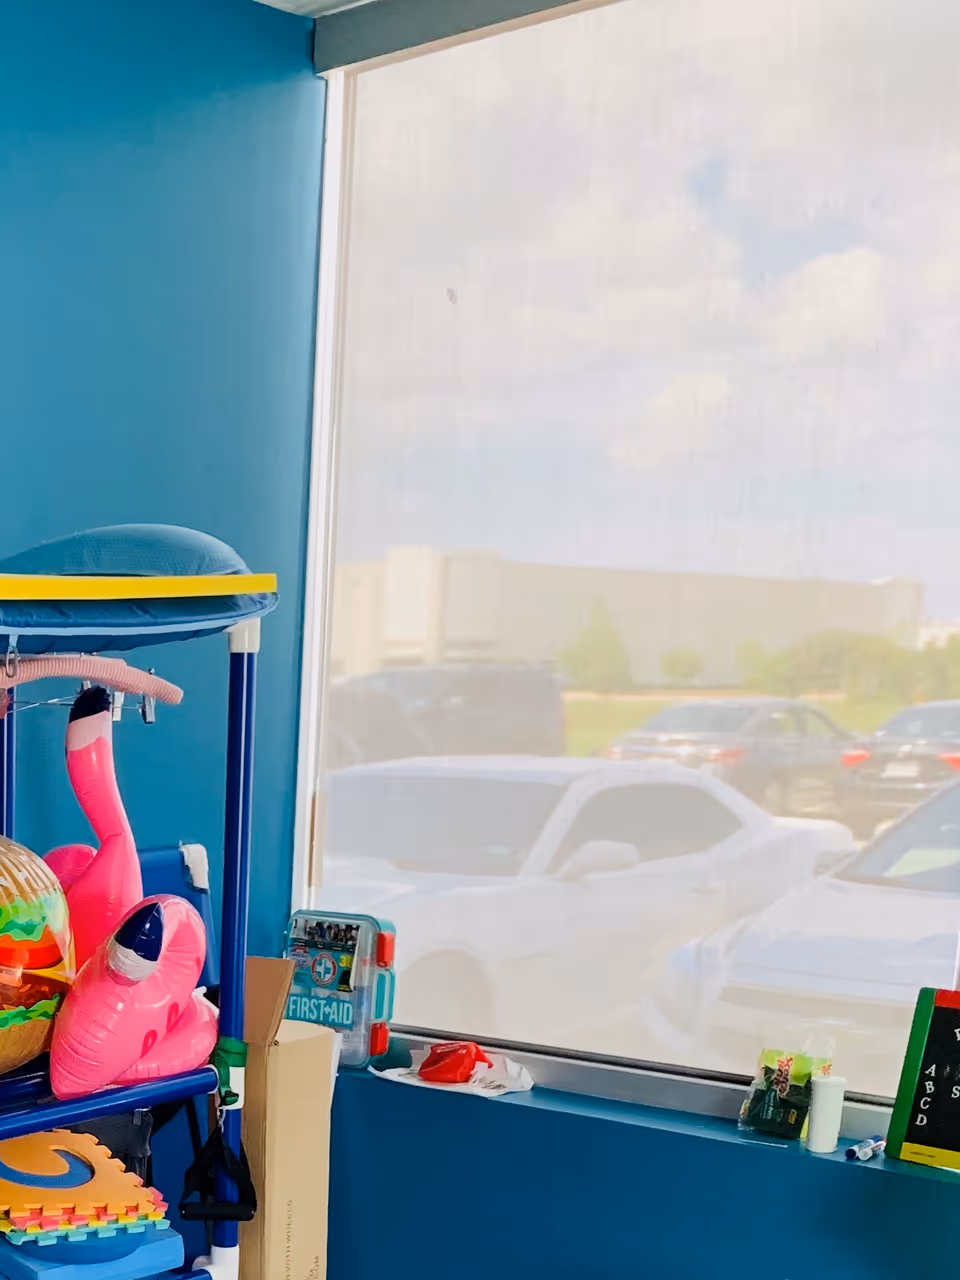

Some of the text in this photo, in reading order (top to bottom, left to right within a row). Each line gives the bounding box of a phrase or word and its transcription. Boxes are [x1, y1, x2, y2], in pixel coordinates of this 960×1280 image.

[289, 996, 353, 1024] FIRST AID
[925, 1063, 937, 1077] A
[924, 1081, 935, 1094] B
[920, 1097, 932, 1110] C
[915, 1113, 928, 1126] D
